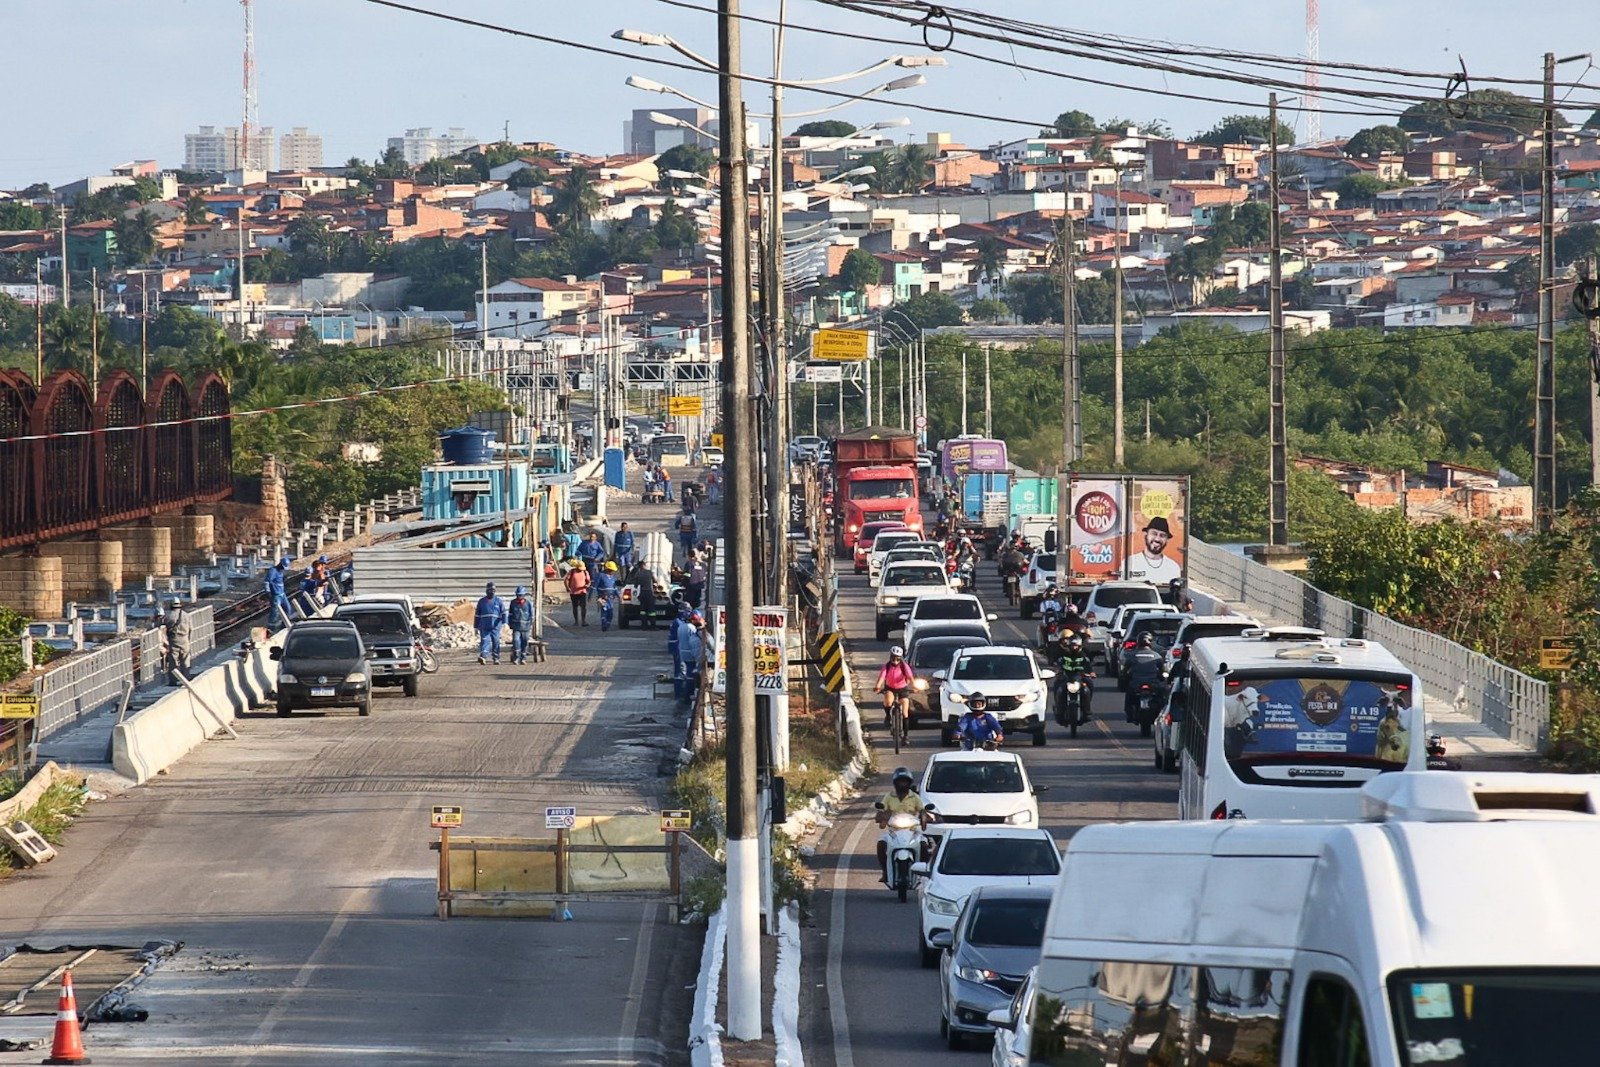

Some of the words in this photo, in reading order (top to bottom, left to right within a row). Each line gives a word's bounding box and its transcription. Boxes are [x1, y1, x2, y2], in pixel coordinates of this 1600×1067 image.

[1082, 514, 1109, 530] TODO
[1083, 554, 1112, 564] TODO
[1360, 706, 1367, 715] A
[1370, 706, 1379, 716] 19
